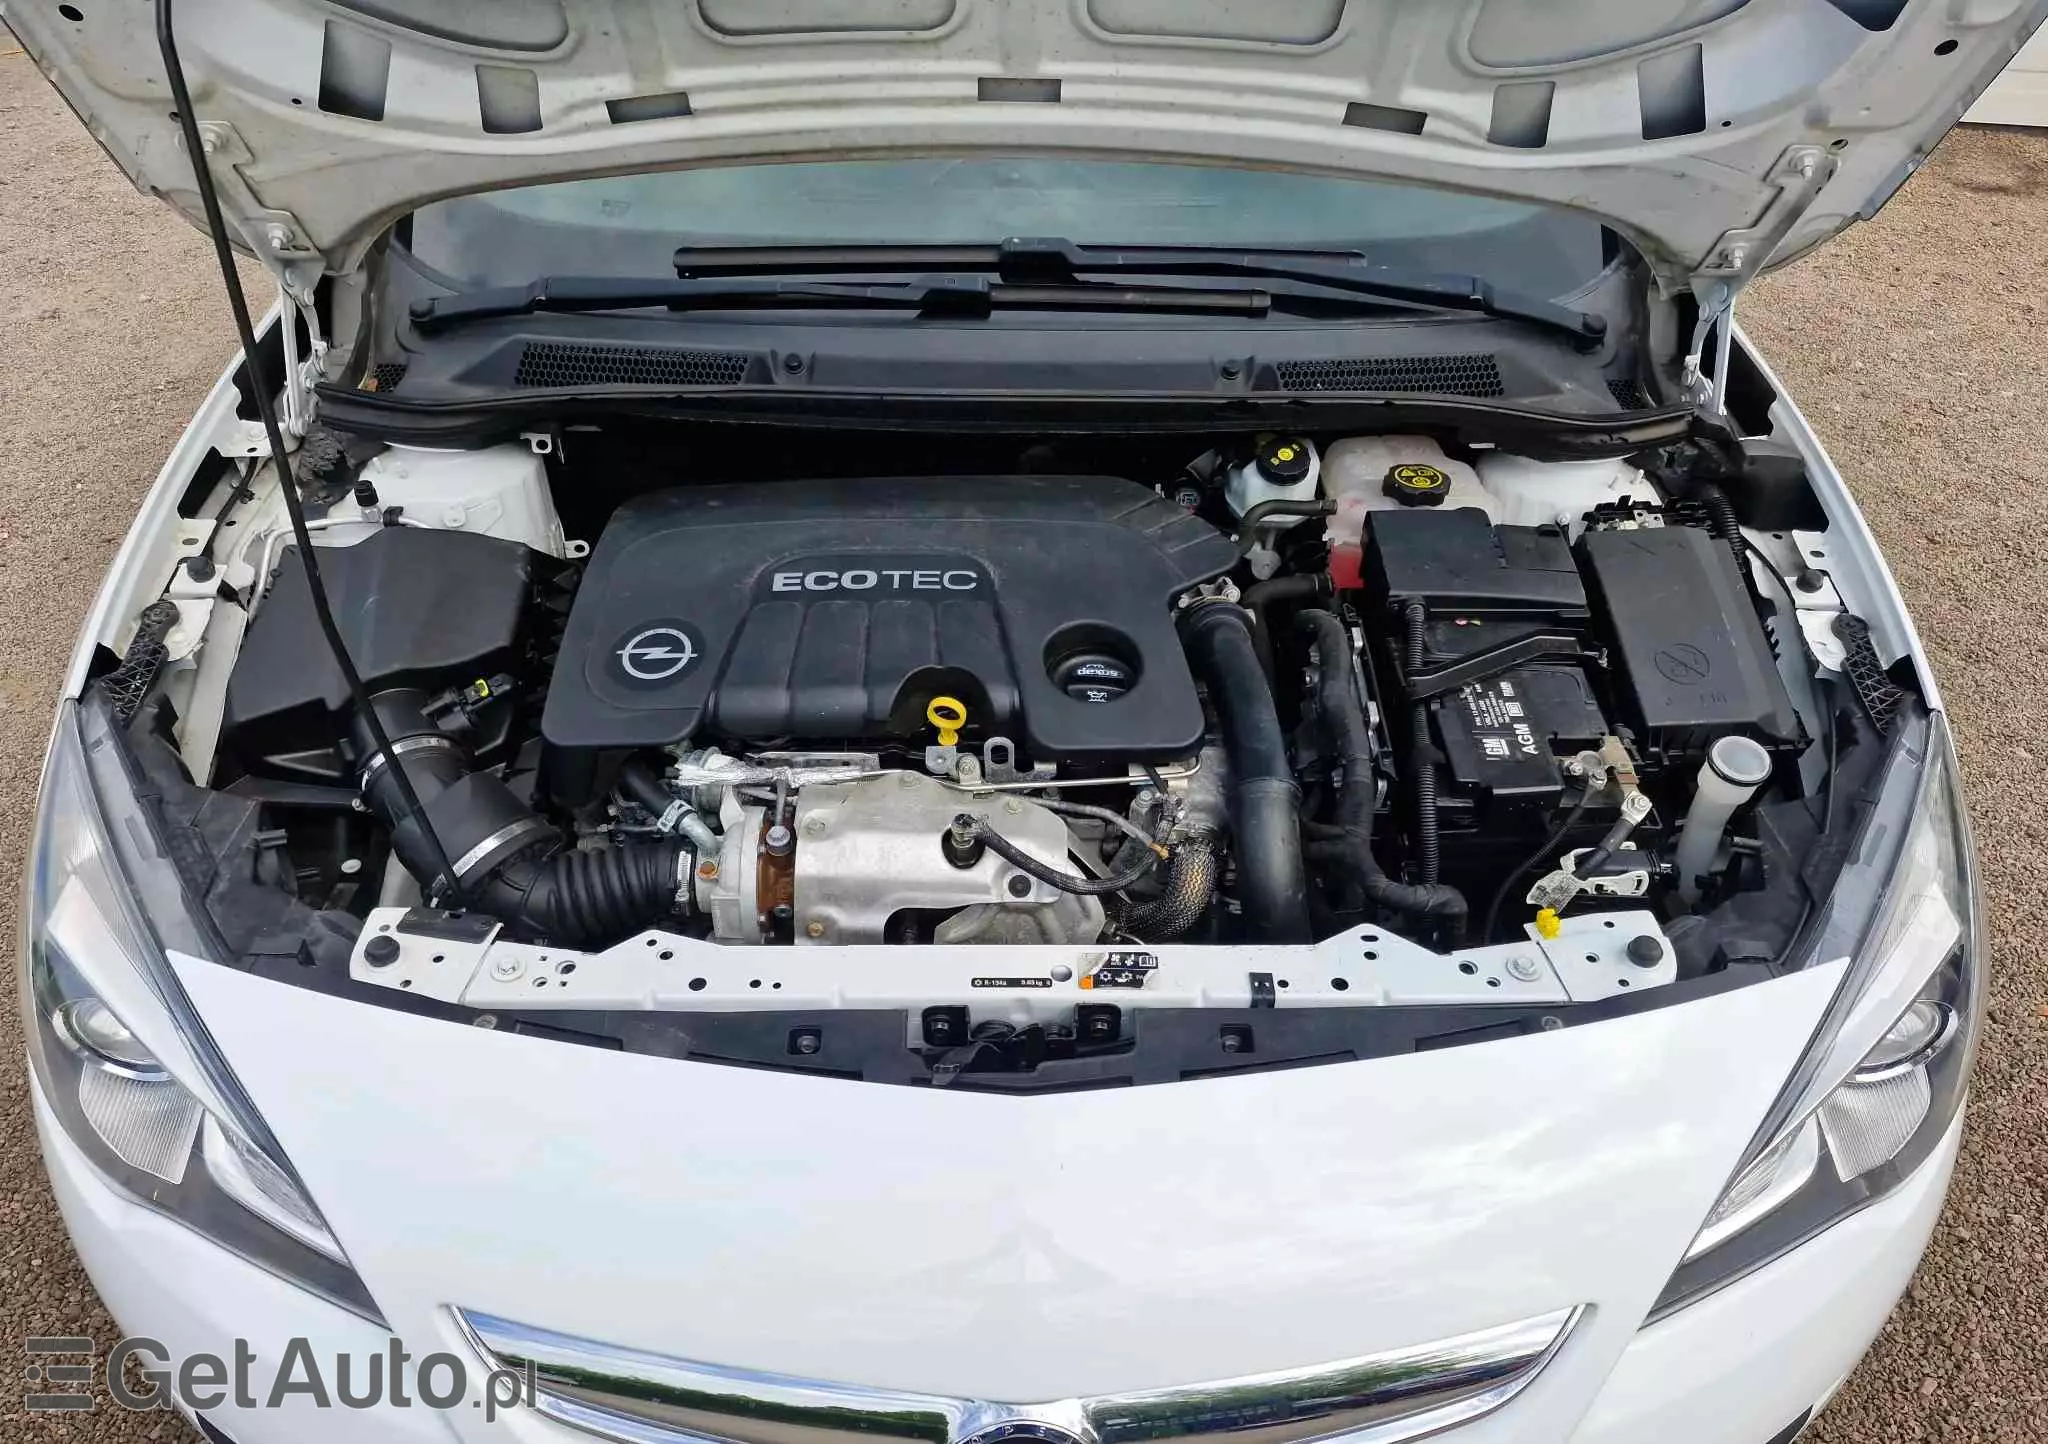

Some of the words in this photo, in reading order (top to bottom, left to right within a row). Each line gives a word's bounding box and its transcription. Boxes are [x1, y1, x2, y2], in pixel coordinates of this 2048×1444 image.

[771, 569, 978, 592] ECOTEC
[1482, 738, 1505, 755] GM
[1513, 723, 1539, 755] AGM
